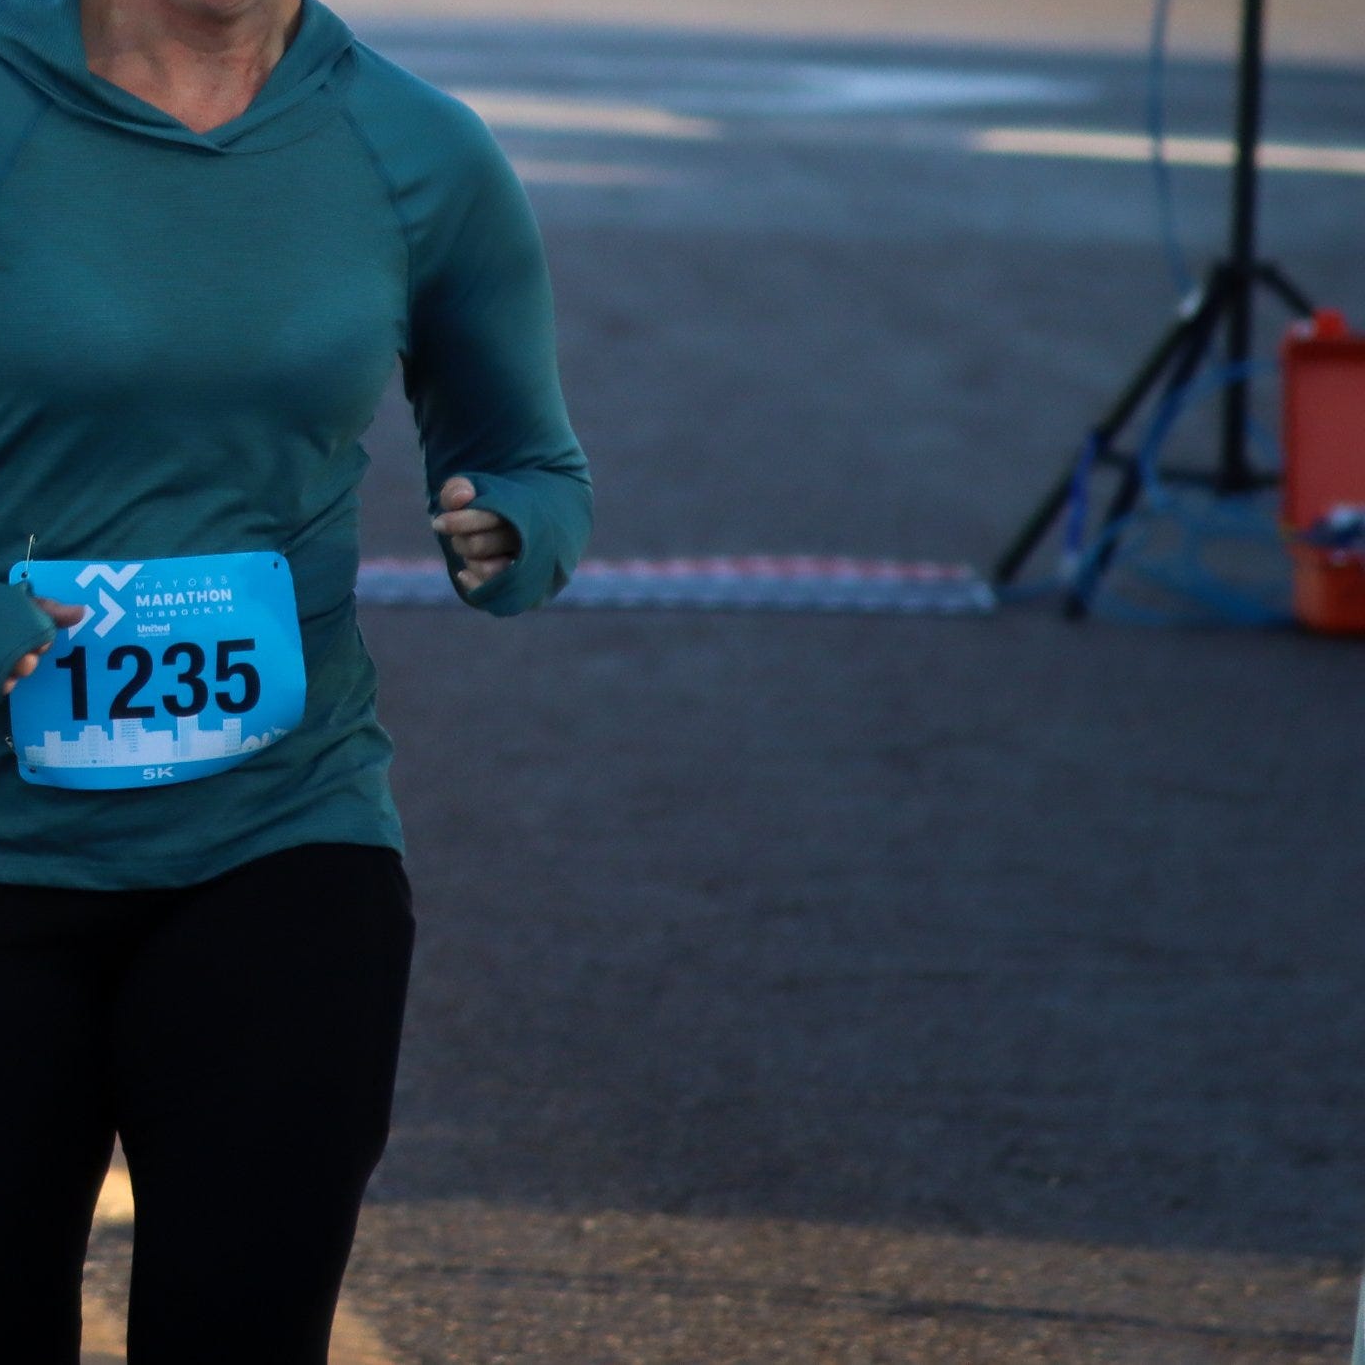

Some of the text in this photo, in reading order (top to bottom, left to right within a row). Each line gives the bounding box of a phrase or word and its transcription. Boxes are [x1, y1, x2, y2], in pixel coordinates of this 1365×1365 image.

[135, 589, 232, 607] MARATHON
[137, 624, 171, 633] United
[55, 638, 261, 721] 1235
[142, 766, 175, 780] 5K
